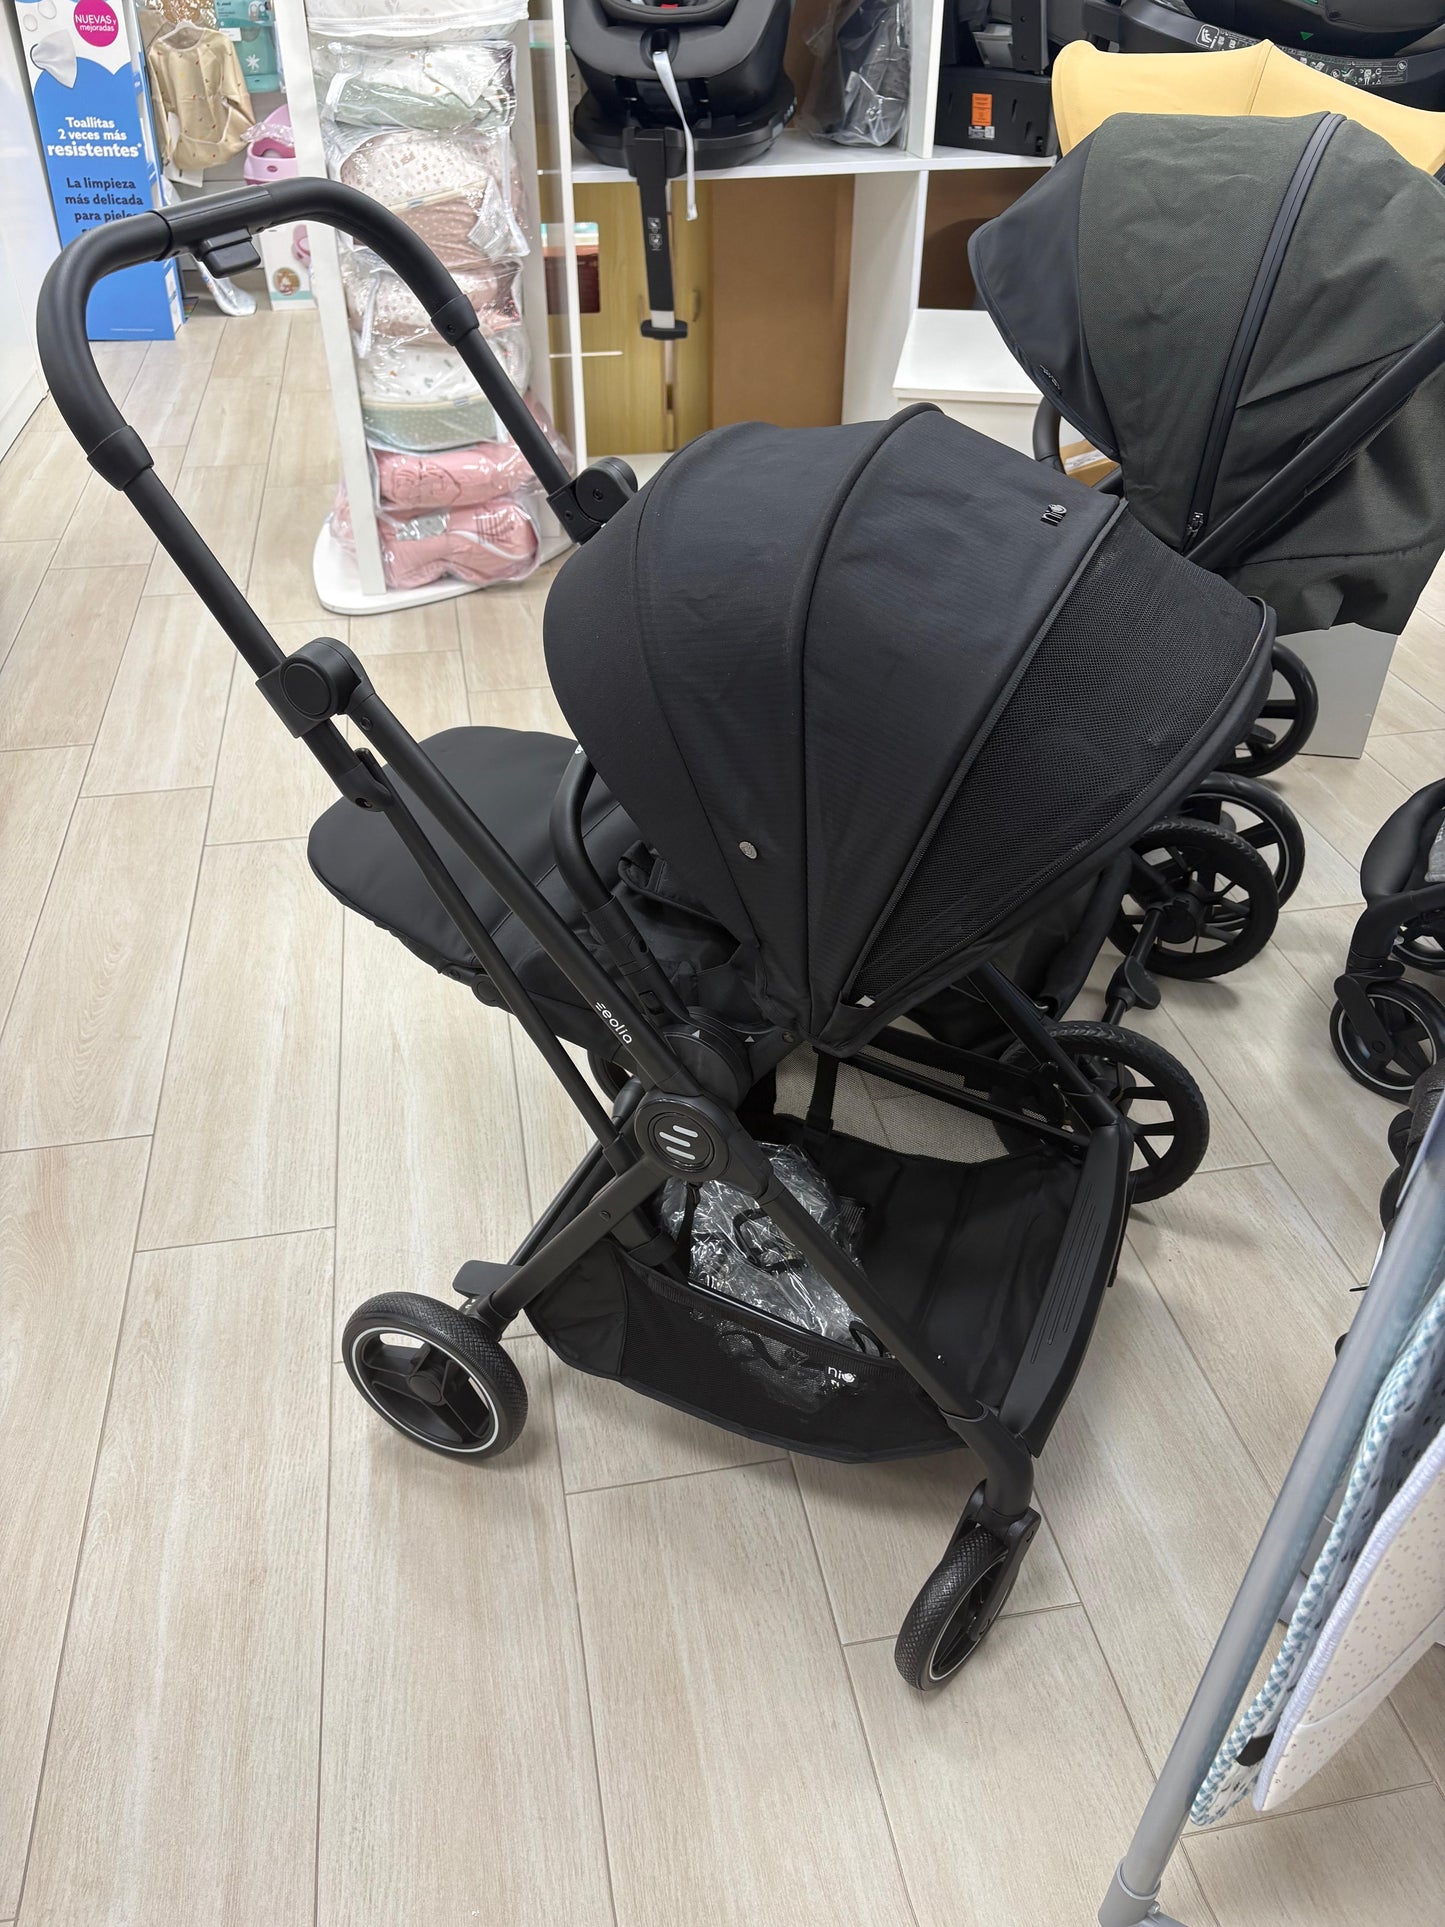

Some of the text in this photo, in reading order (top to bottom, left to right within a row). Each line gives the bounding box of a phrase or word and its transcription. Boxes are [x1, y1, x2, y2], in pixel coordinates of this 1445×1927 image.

[74, 14, 112, 24] NUEVAS
[80, 23, 115, 33] mejoradas
[65, 116, 115, 129] Toallitas
[58, 129, 127, 141] 2 veces más
[66, 176, 136, 191] La limpieza
[64, 194, 144, 206] más delicada
[74, 209, 138, 223] para piele
